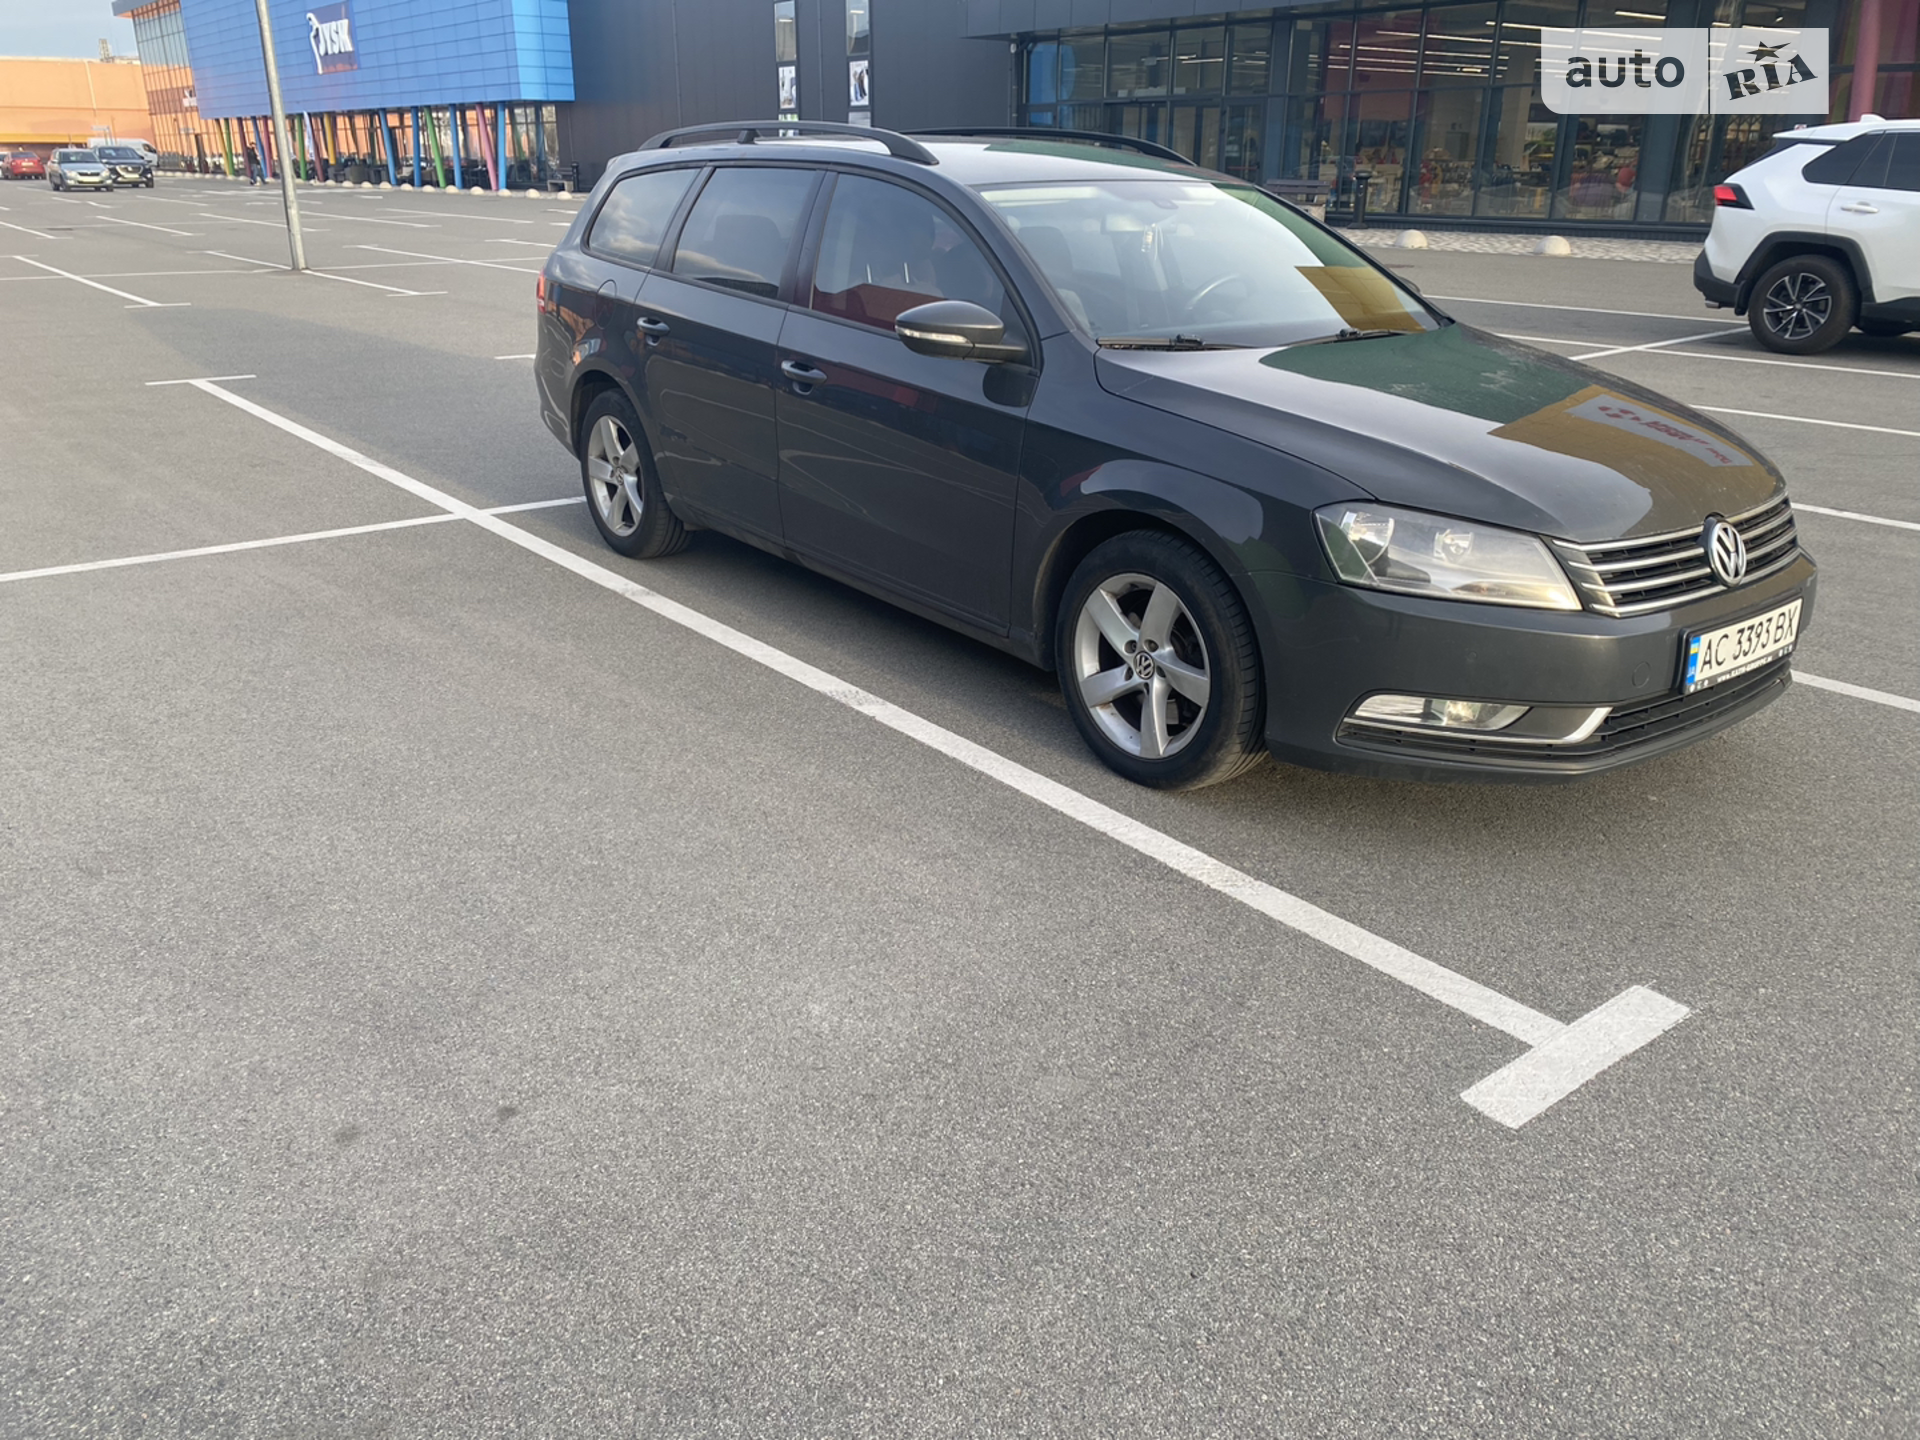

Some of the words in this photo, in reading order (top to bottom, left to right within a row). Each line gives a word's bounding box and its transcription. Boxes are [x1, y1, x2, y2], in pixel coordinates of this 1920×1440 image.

[1700, 634, 1729, 673] AC
[1732, 617, 1773, 661] 3393
[1773, 605, 1798, 645] BX
